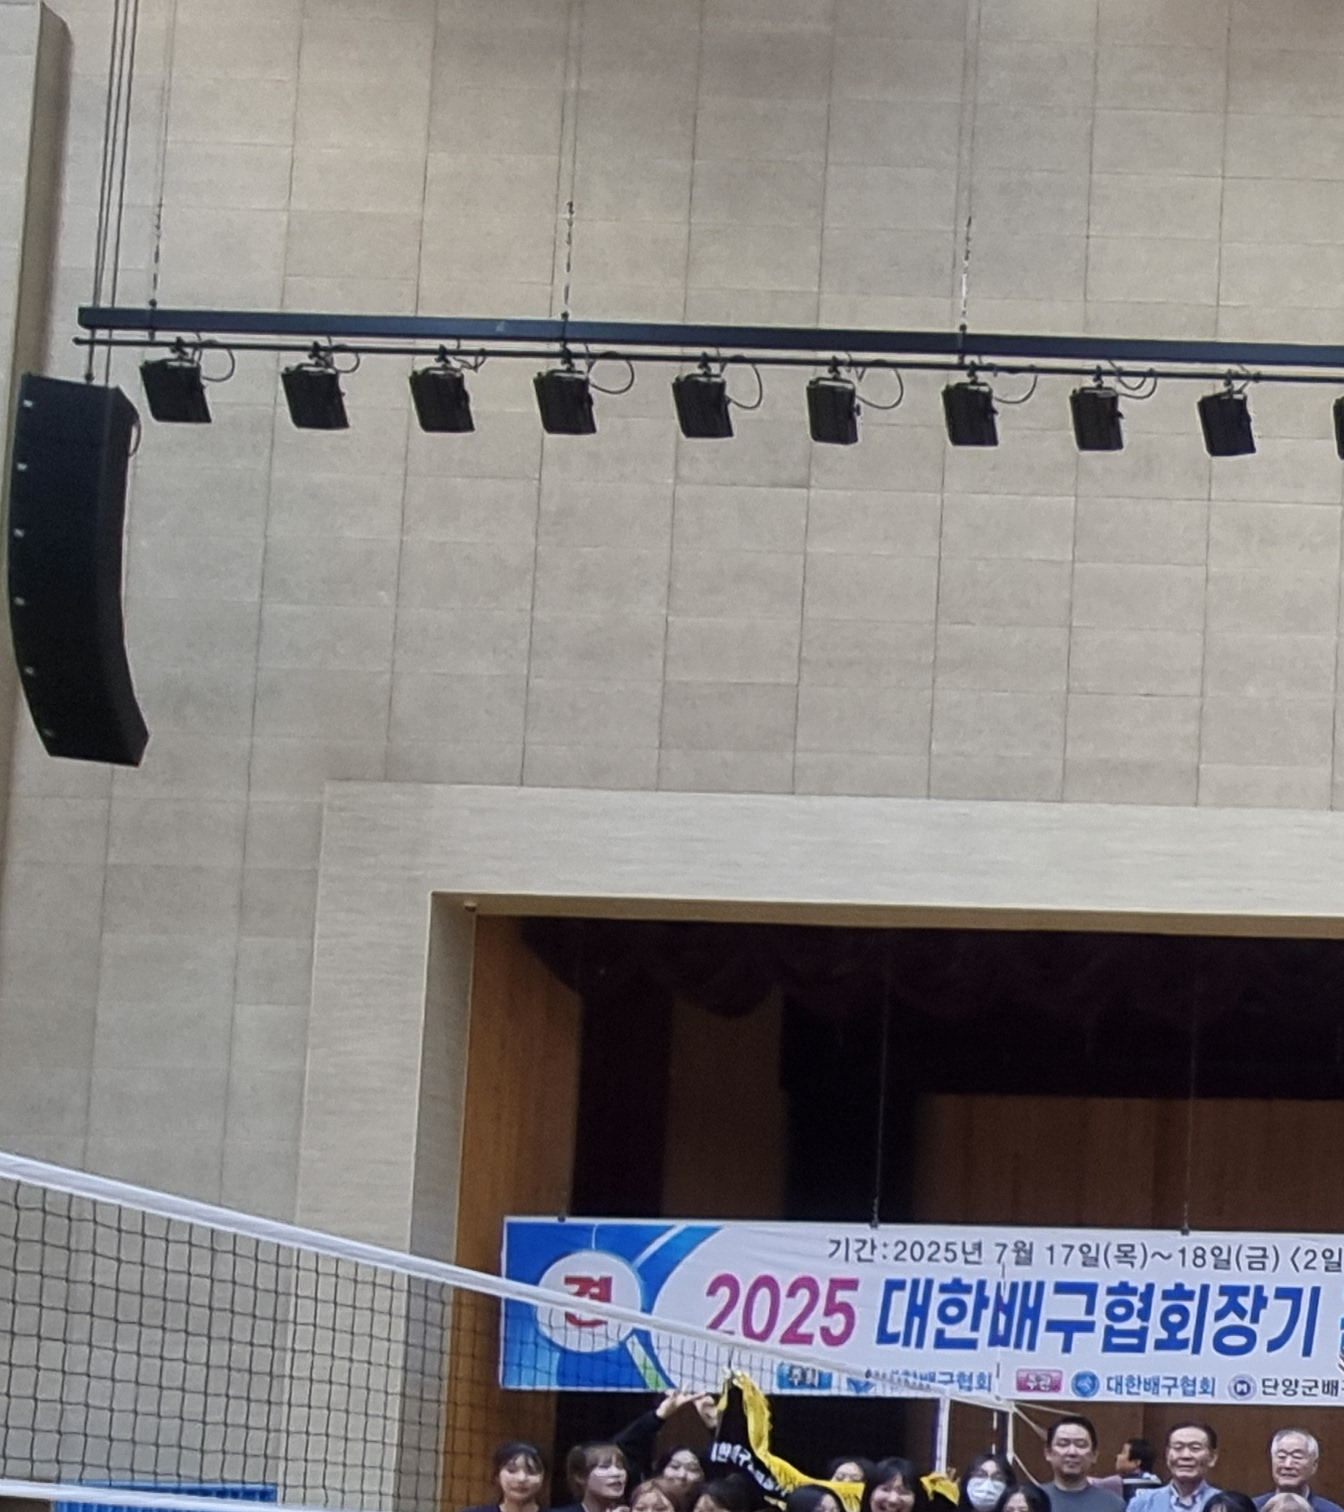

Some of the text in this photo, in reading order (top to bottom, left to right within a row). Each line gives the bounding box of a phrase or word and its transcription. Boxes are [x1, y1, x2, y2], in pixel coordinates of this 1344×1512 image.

[828, 1238, 983, 1265] 기간:2025년
[994, 1242, 1035, 1267] 7월
[706, 1273, 860, 1348] 2025
[875, 1276, 1322, 1358] 대한배구협회장기
[1105, 1375, 1217, 1397] 대한배구협회
